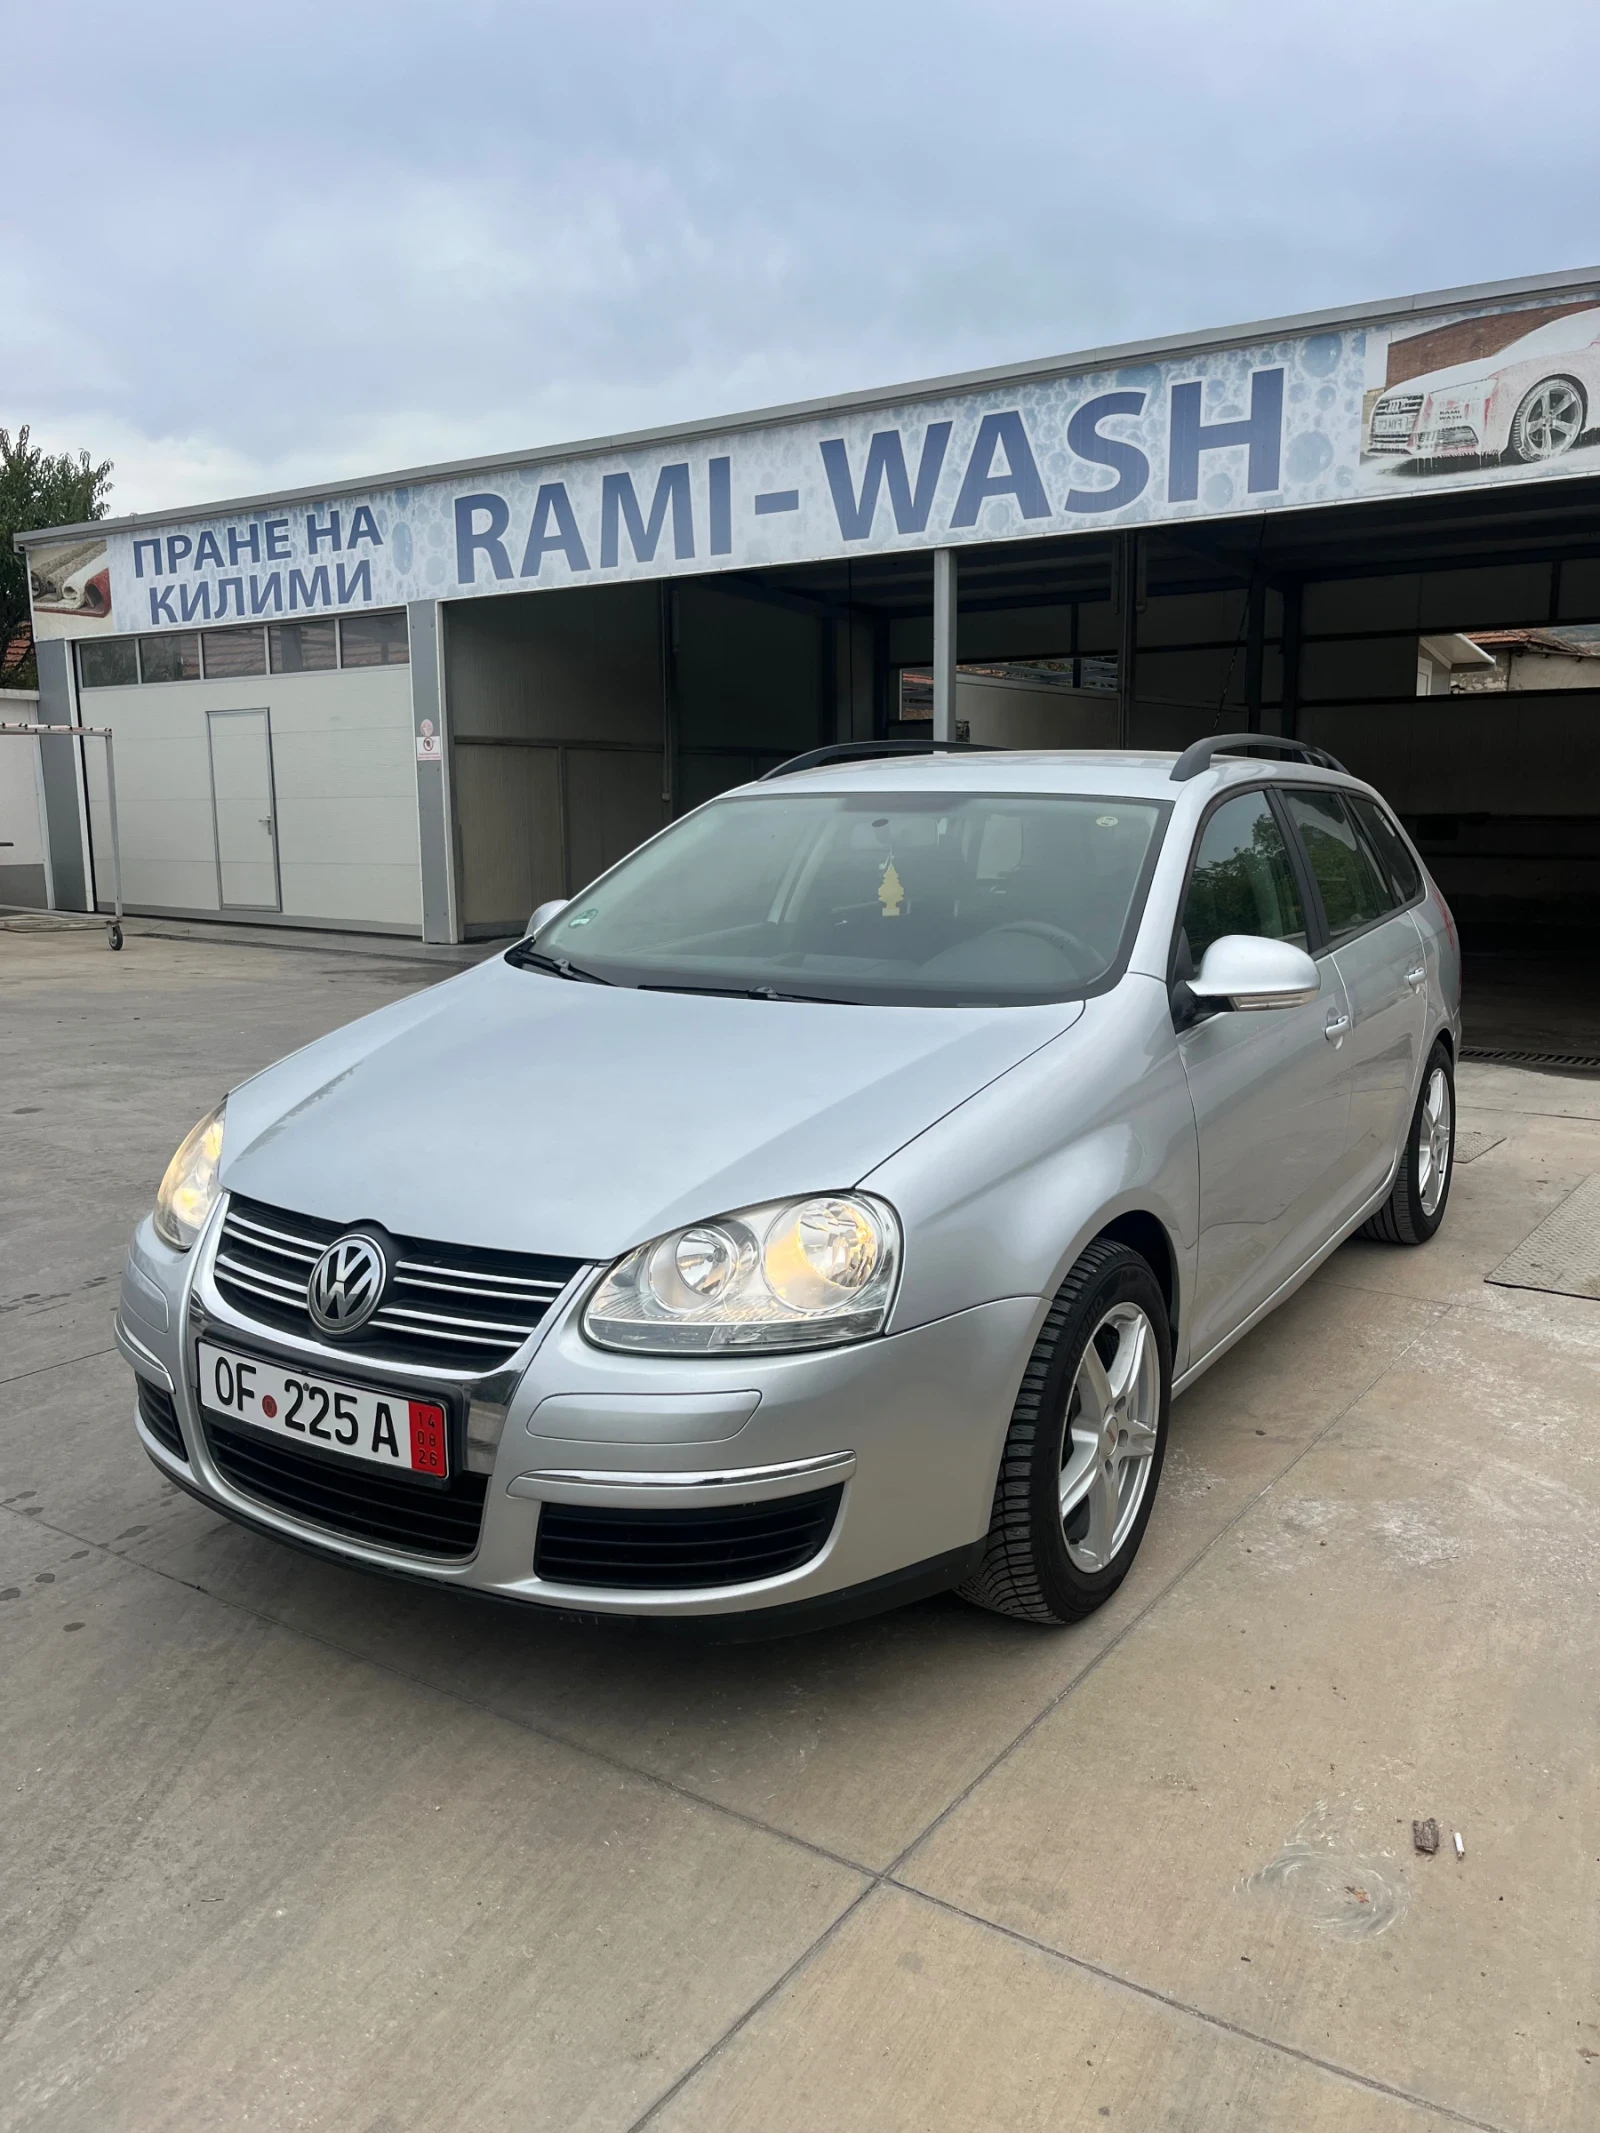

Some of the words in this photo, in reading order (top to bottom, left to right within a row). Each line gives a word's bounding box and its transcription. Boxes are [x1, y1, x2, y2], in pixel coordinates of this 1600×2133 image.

[133, 518, 292, 578] ПРАНЕ
[306, 505, 383, 555] НА
[149, 559, 372, 625] КИЛИМИ
[215, 1356, 257, 1412] OF
[284, 1379, 359, 1446] 225
[371, 1402, 399, 1458] A
[418, 1412, 435, 1428] 14
[417, 1431, 437, 1447] 08
[418, 1449, 437, 1466] 26
